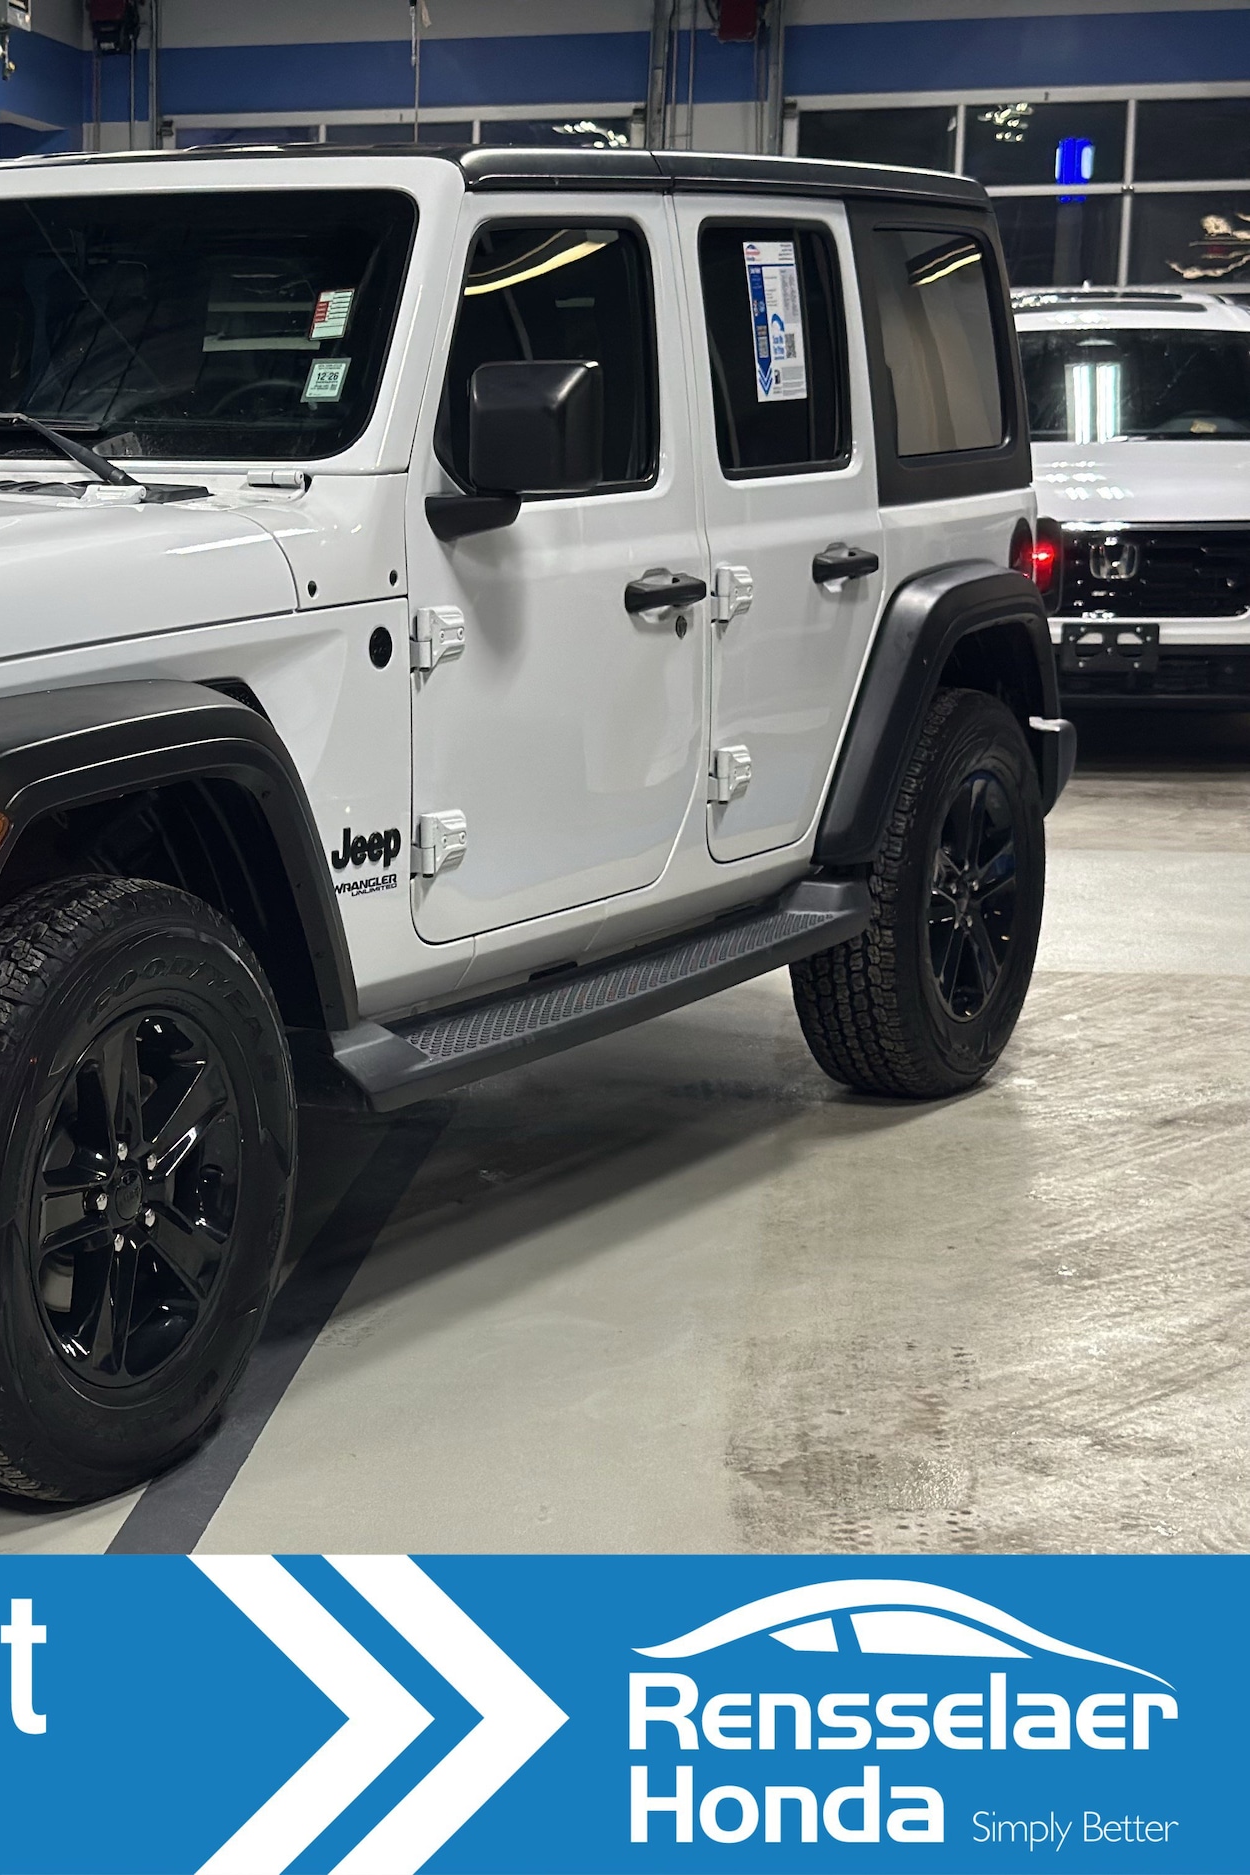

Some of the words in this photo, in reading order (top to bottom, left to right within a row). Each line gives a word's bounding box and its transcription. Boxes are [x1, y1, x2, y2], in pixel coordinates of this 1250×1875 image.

[331, 827, 401, 870] Jeep
[335, 873, 397, 894] WRANGLER
[351, 883, 397, 897] UNLIMITED
